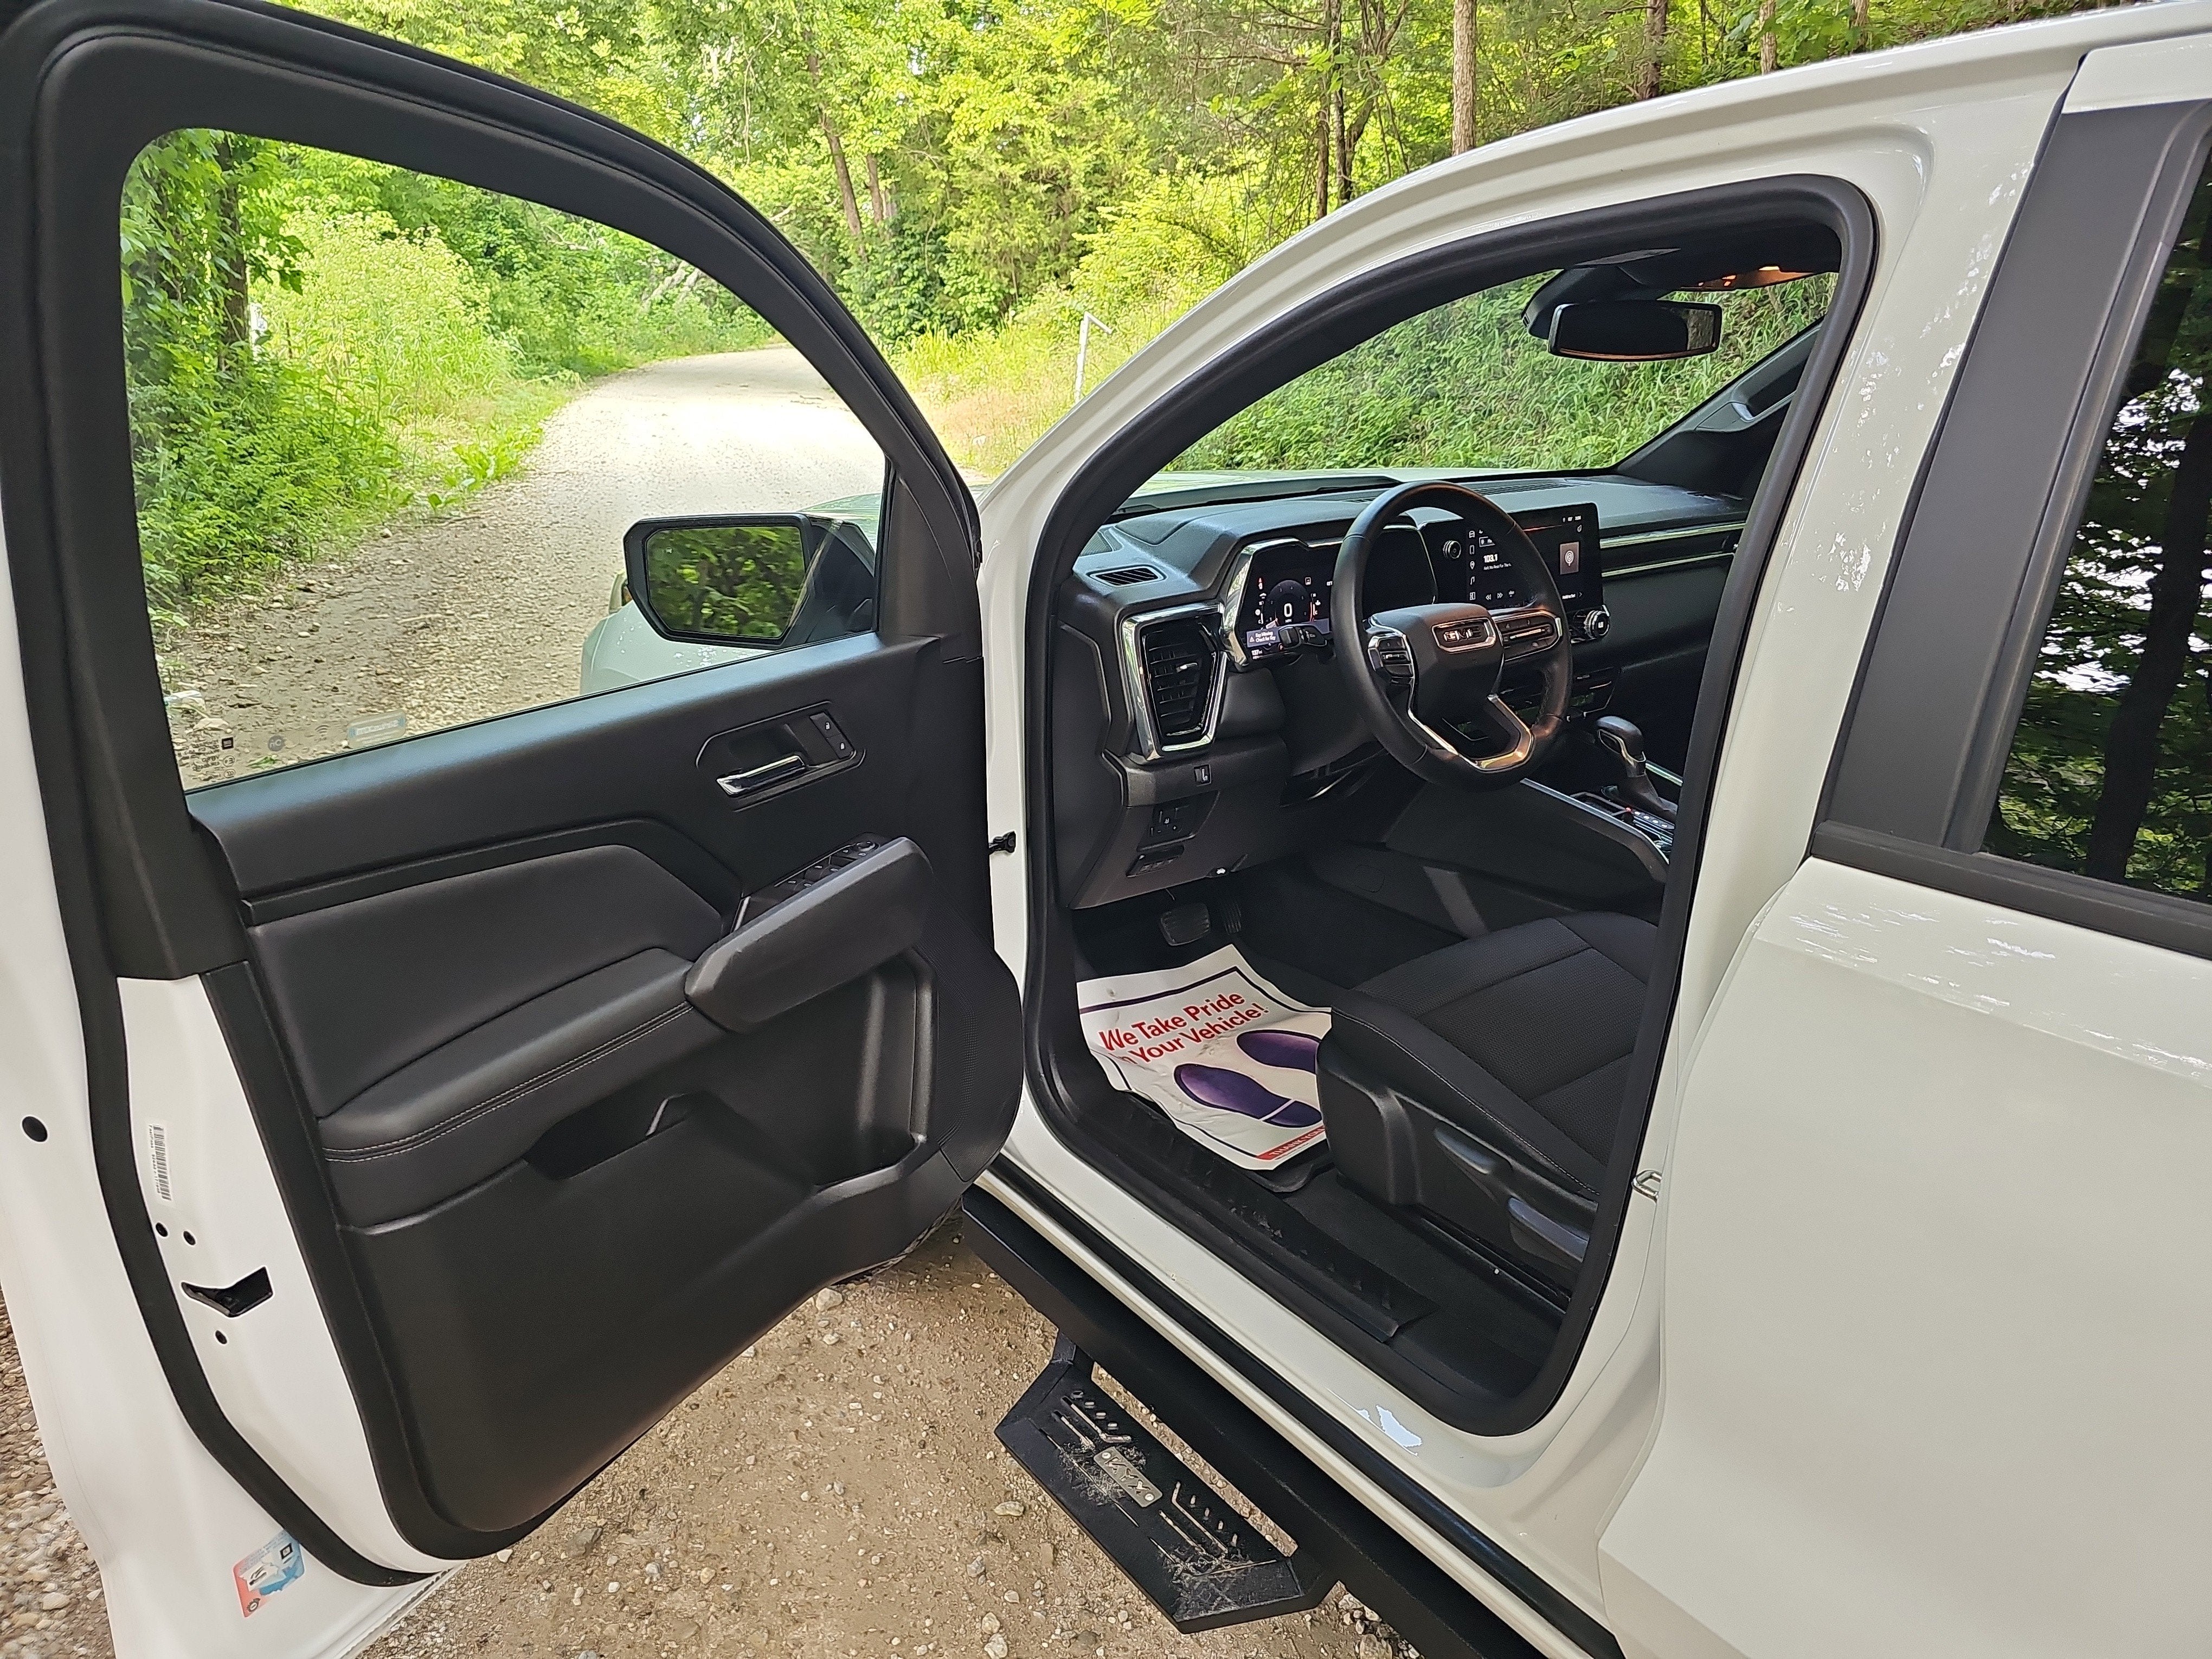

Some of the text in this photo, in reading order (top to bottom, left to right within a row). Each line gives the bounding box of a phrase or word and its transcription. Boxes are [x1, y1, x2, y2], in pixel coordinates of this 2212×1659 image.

[1098, 994, 1245, 1051] We Take Pride
[1128, 1038, 1185, 1062] Your
[1178, 1002, 1269, 1043] Vehicle!
[1268, 1139, 1307, 1156] THANK
